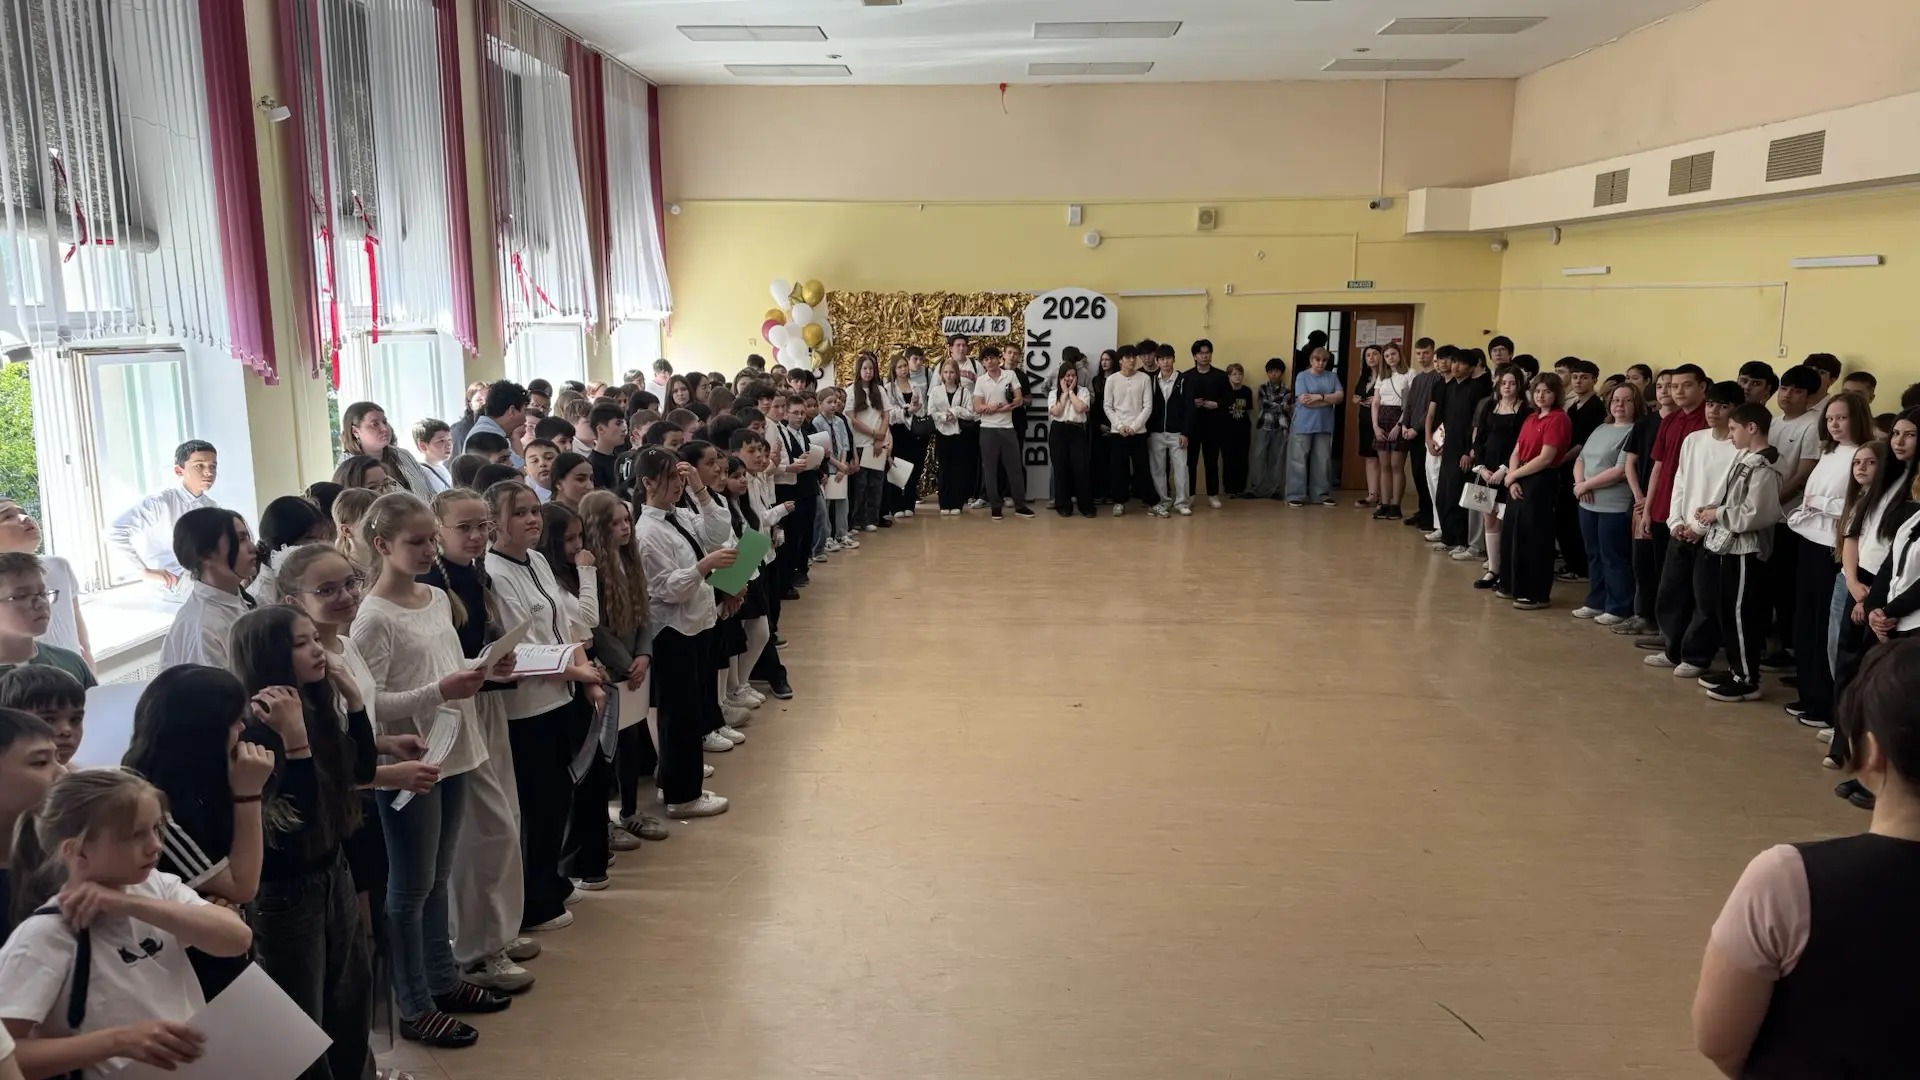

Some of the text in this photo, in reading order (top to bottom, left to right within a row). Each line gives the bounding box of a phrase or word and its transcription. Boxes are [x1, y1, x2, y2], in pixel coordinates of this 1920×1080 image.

[1042, 296, 1106, 319] 2026
[944, 318, 1006, 333] ШКОЛА 183
